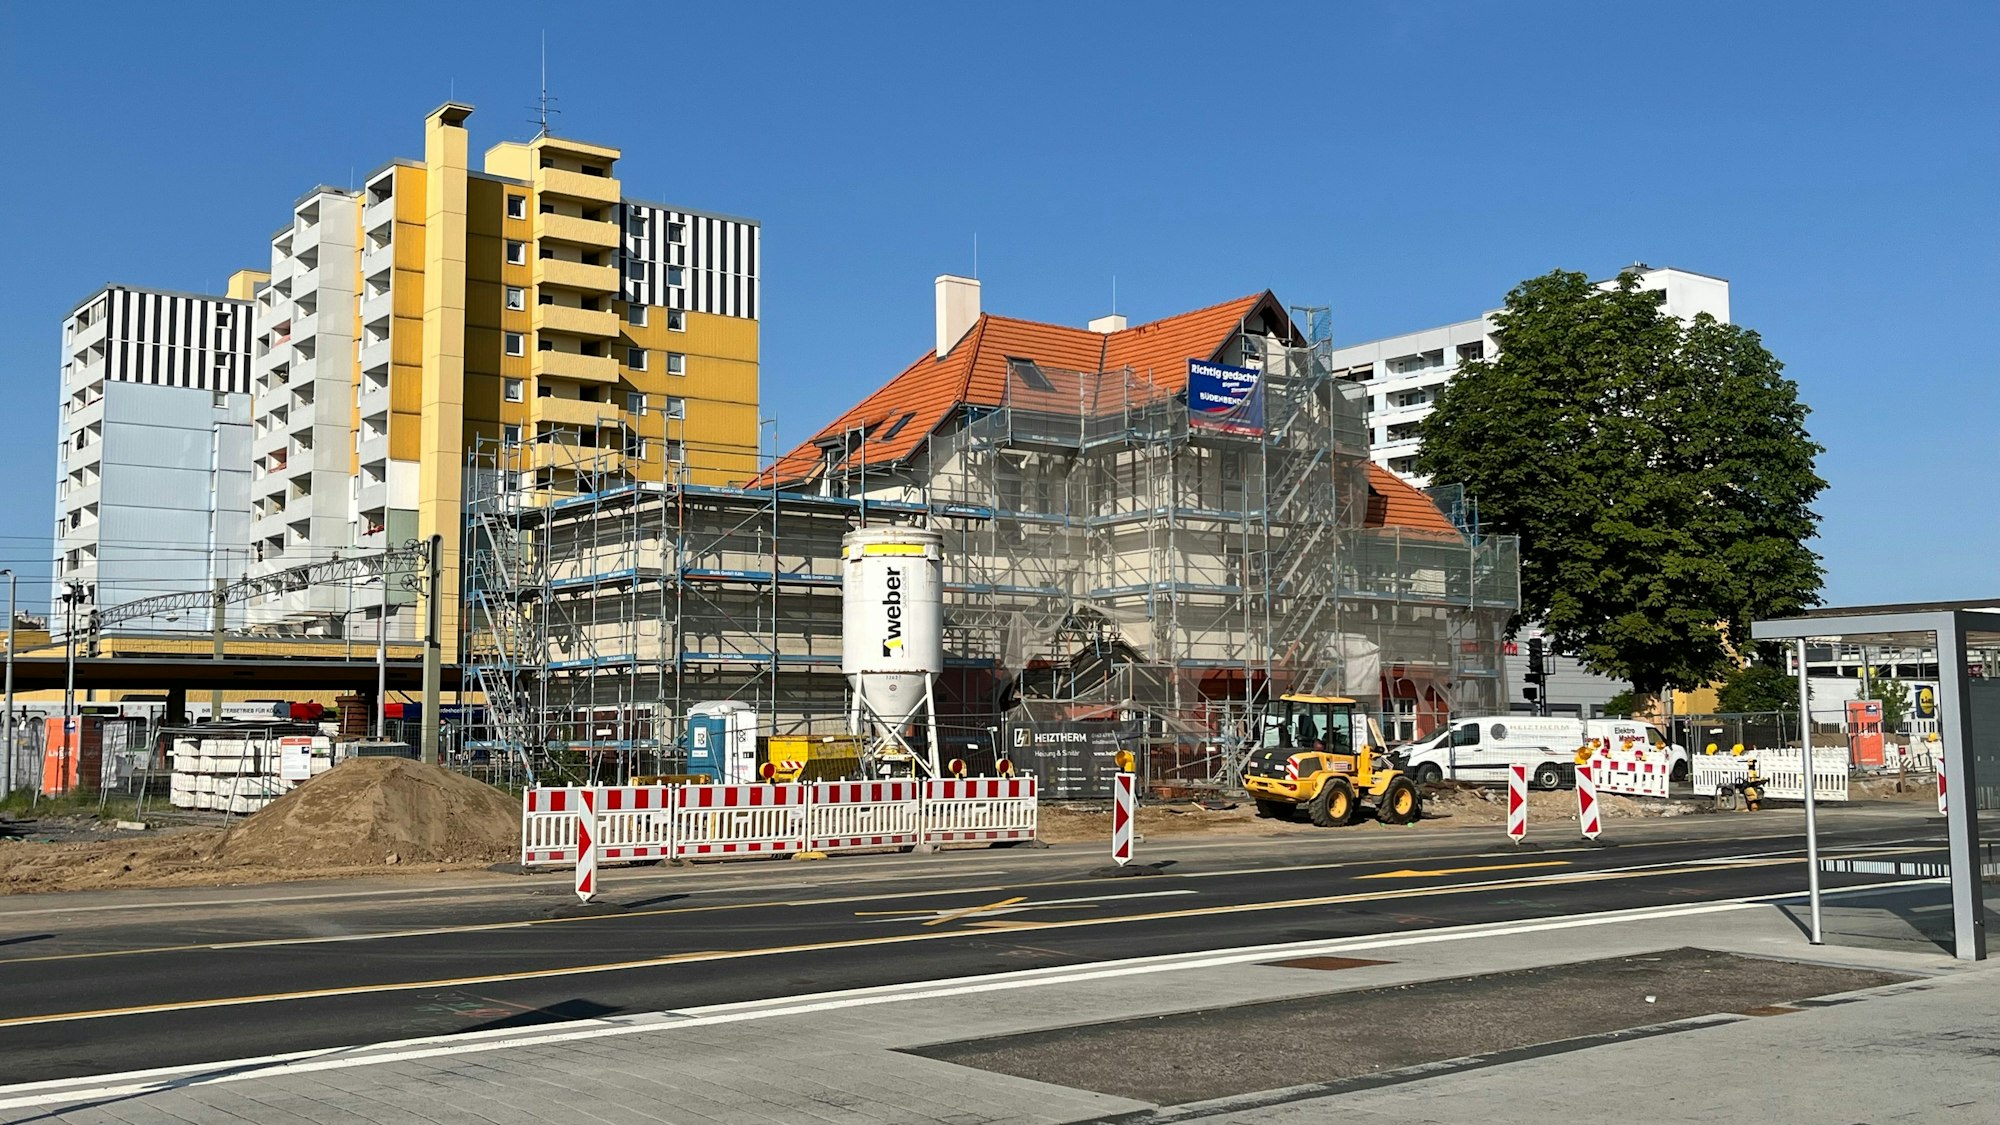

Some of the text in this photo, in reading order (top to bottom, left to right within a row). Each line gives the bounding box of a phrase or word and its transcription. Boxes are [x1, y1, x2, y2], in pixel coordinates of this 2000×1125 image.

[1191, 364, 1221, 379] Richtig
[882, 567, 901, 640] weber
[1034, 733, 1087, 742] HEIZTHERM
